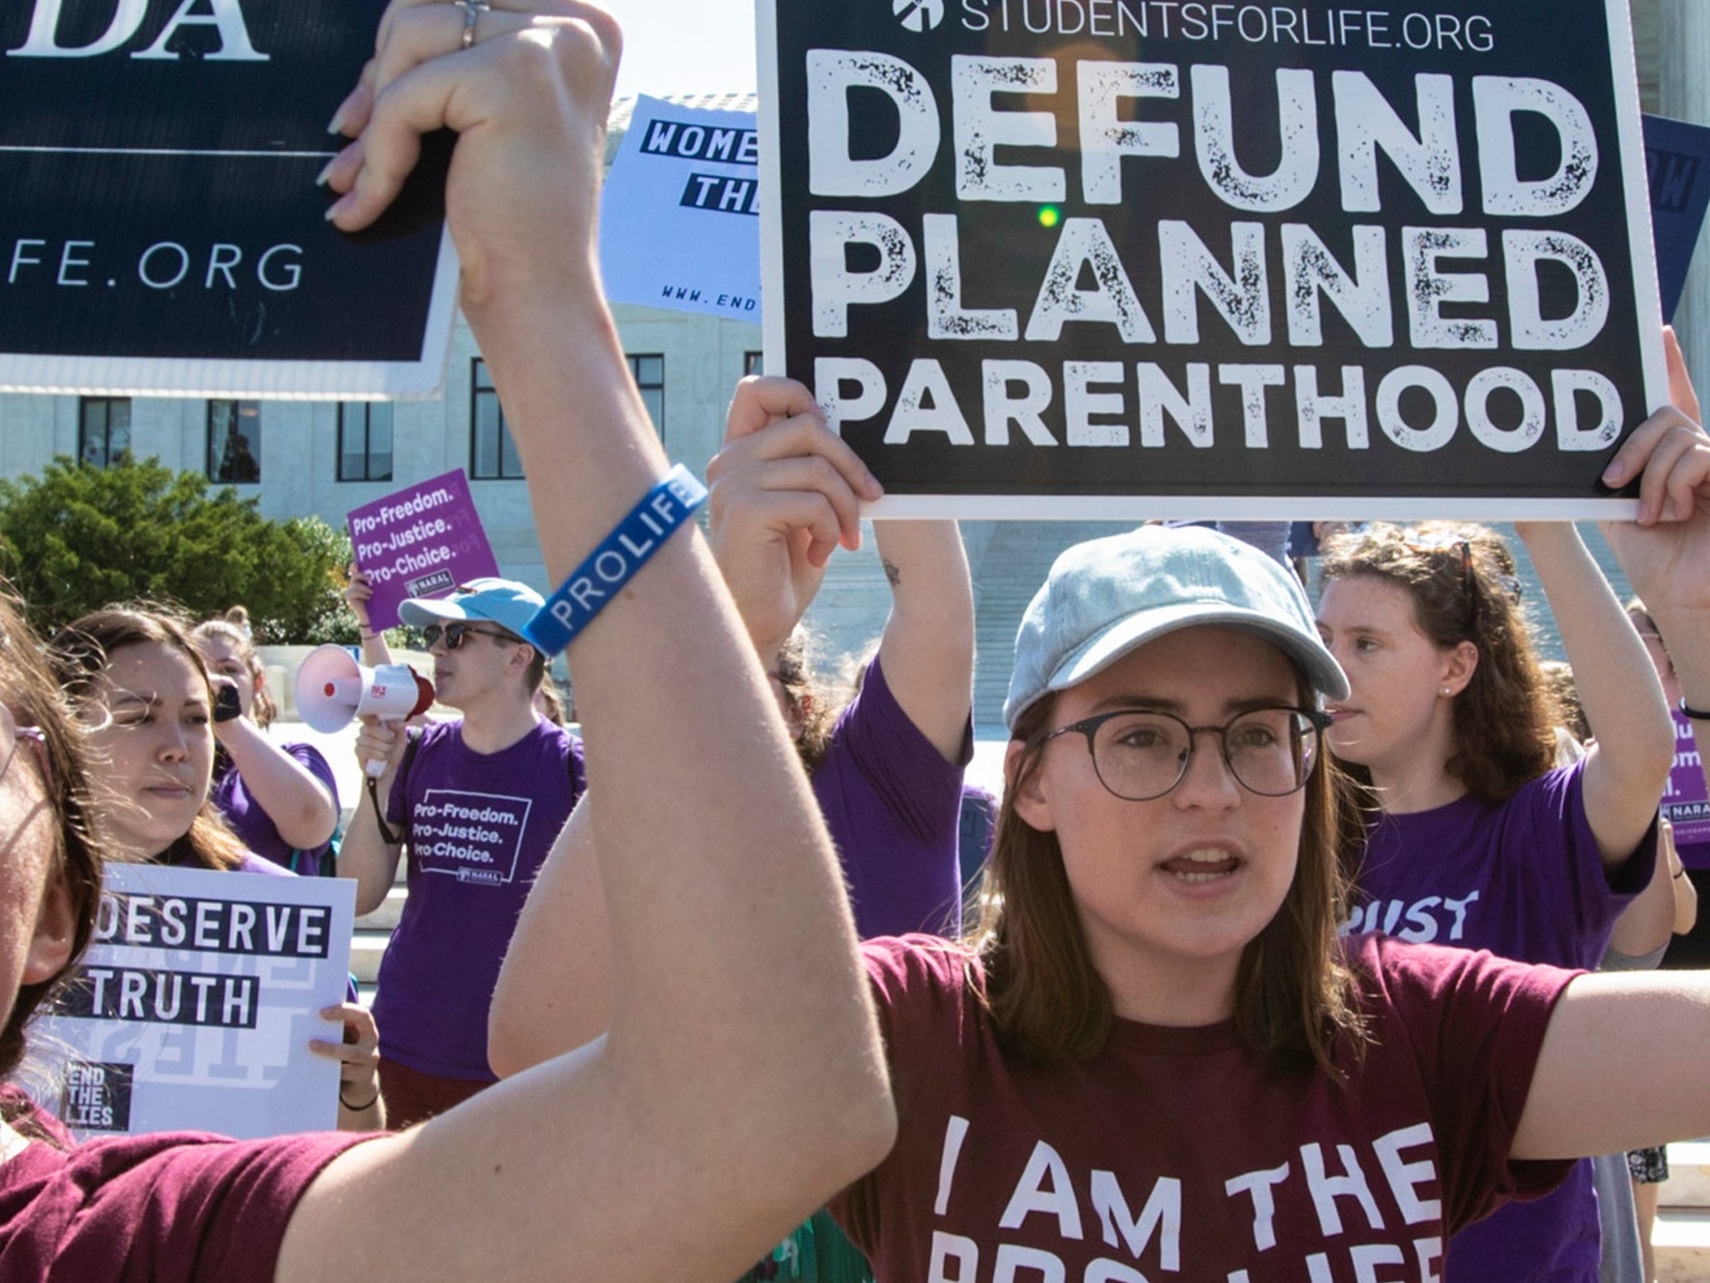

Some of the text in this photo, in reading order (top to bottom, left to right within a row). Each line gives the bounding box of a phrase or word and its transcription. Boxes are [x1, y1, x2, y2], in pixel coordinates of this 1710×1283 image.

[805, 47, 1601, 217] DEFUND
[695, 177, 759, 214] TH
[808, 209, 1612, 351] PLANNED
[814, 357, 1625, 455] PARENTHOOD
[353, 488, 454, 537] Pro-Freedom.
[358, 518, 453, 562] Pro-Justice.
[550, 480, 697, 631] PROLIFE
[364, 545, 457, 587] Pro-Choice.
[413, 823, 503, 844] Pro-Justice.
[414, 803, 519, 826] Pro-Freedom.
[94, 894, 327, 955] DESERVE
[87, 969, 252, 1026] TRUTH
[68, 1064, 105, 1086] END
[69, 1086, 103, 1106] THE
[933, 1115, 1444, 1273] I AM THE
